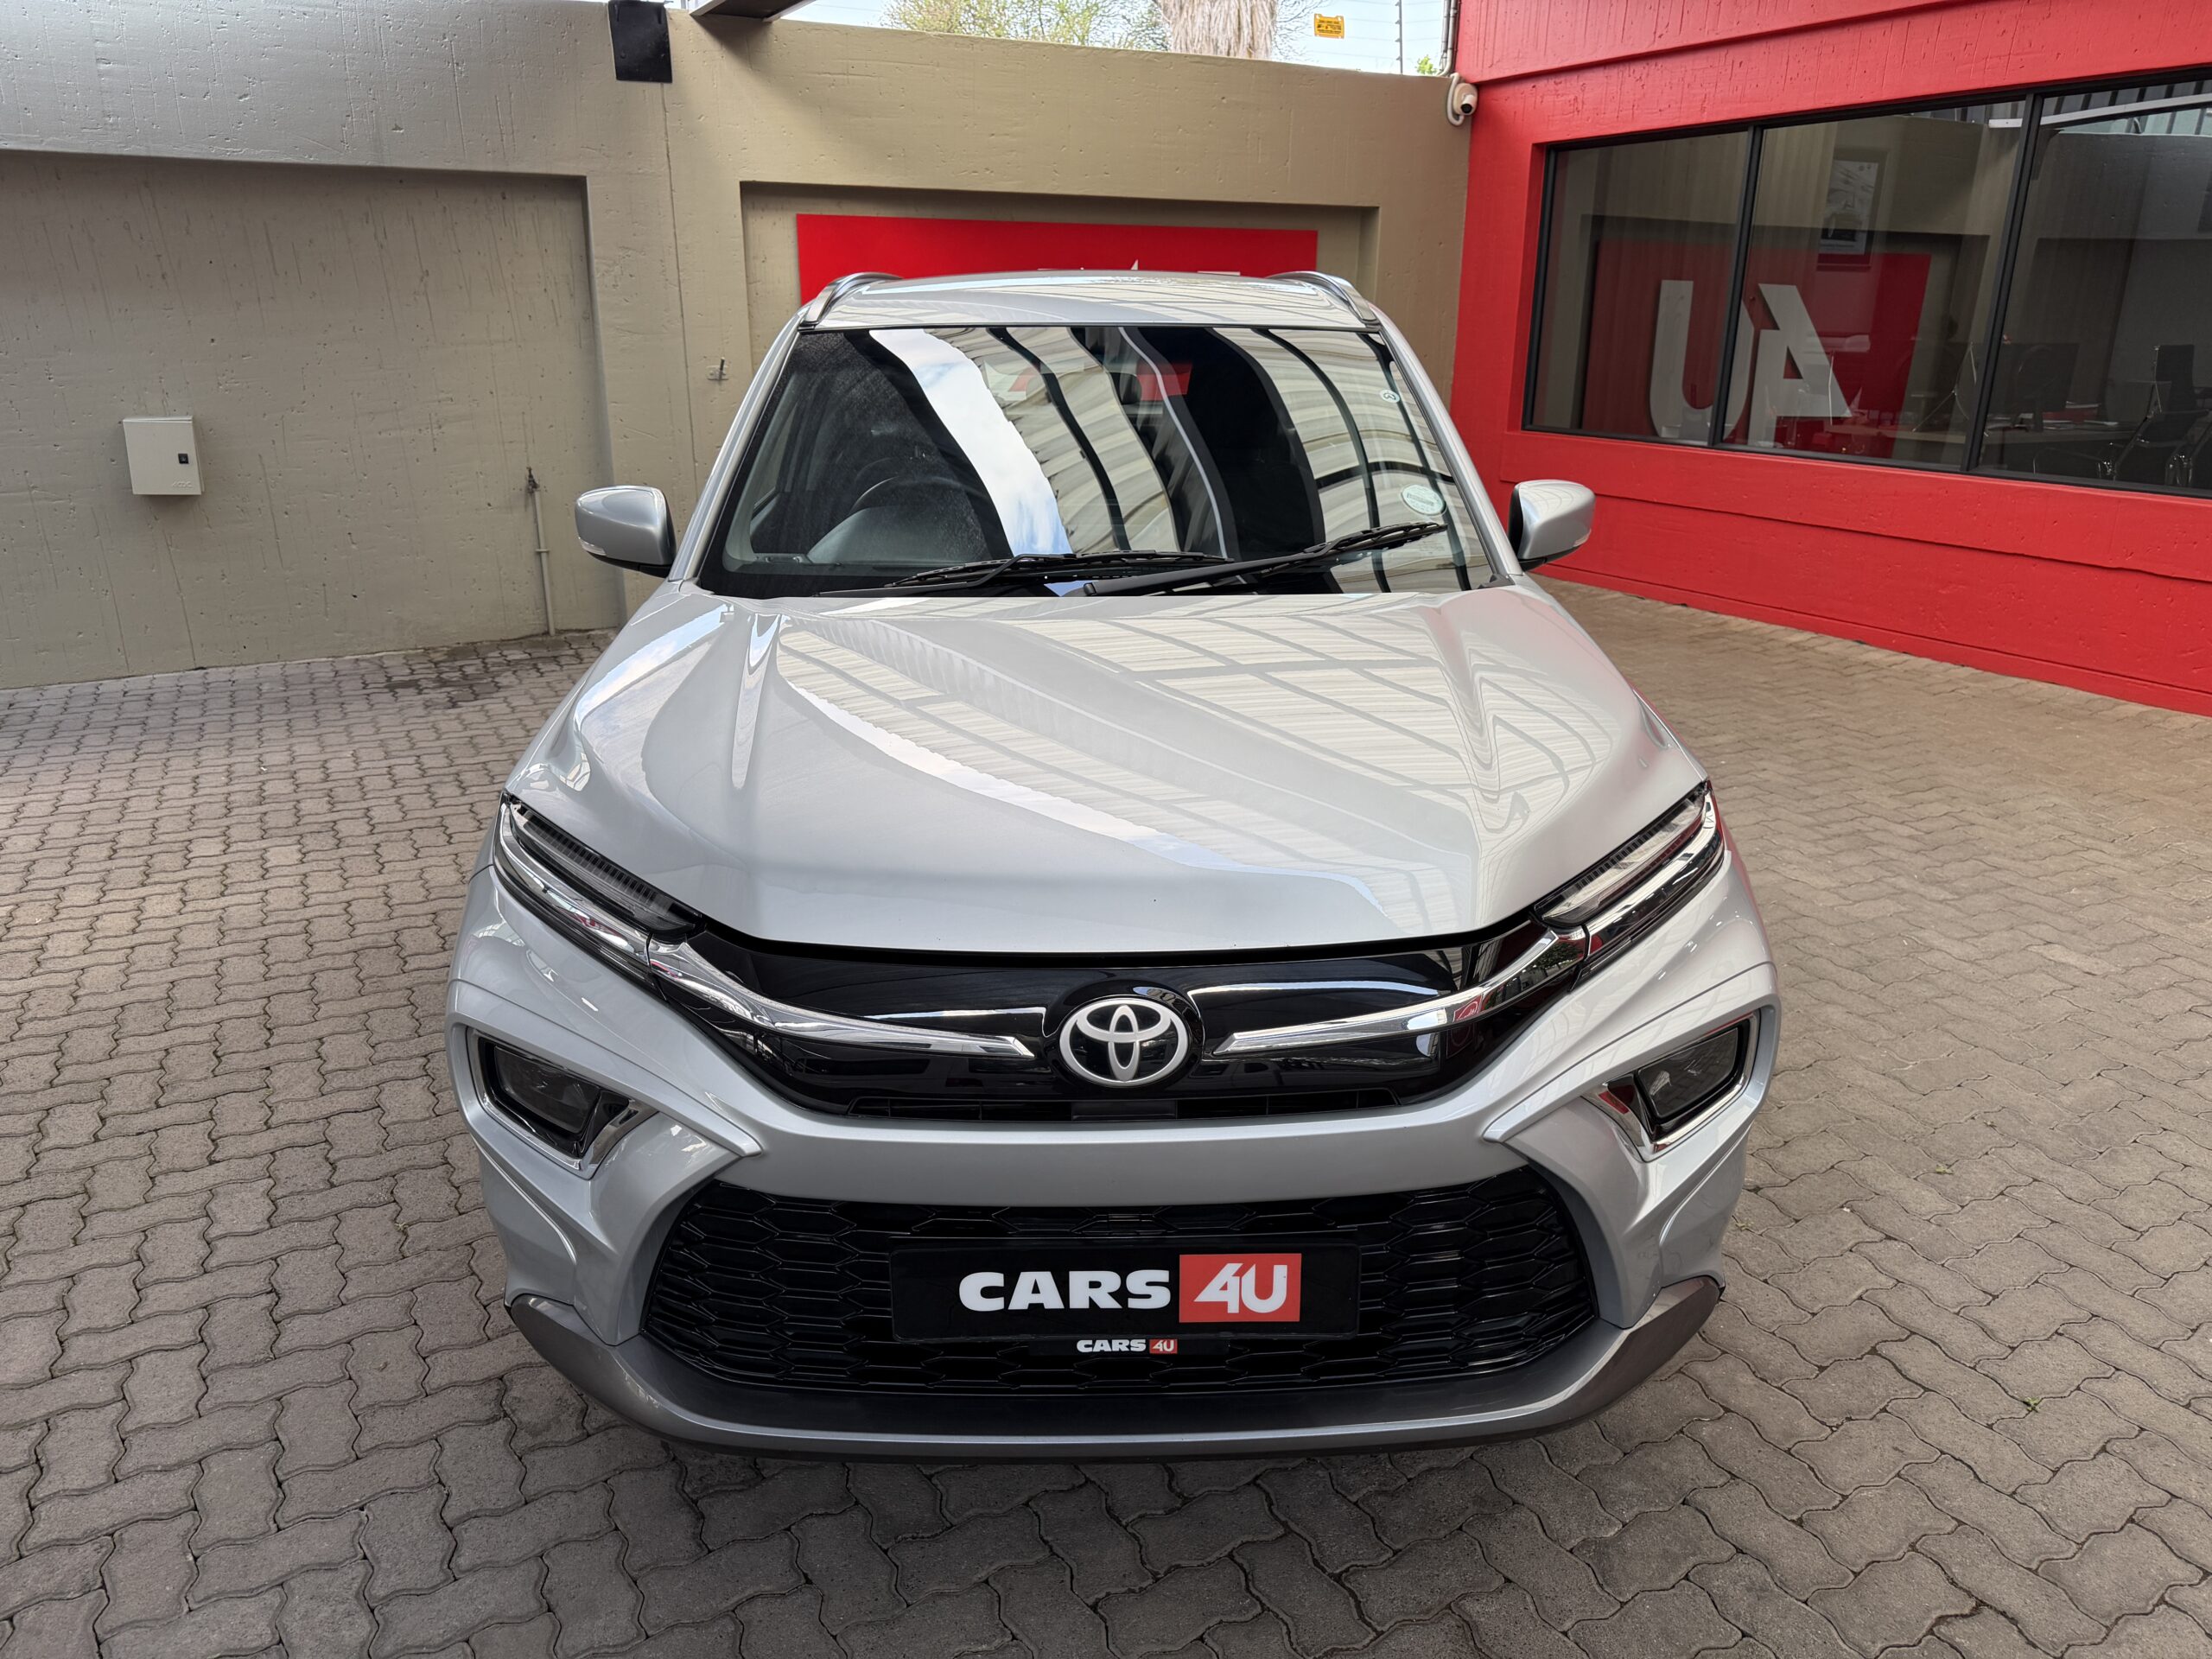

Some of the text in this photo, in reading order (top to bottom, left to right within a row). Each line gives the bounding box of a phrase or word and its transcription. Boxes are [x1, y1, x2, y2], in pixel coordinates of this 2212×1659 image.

[958, 1262, 1288, 1314] CARS 4U
[1076, 1338, 1175, 1354] CARS 4U
